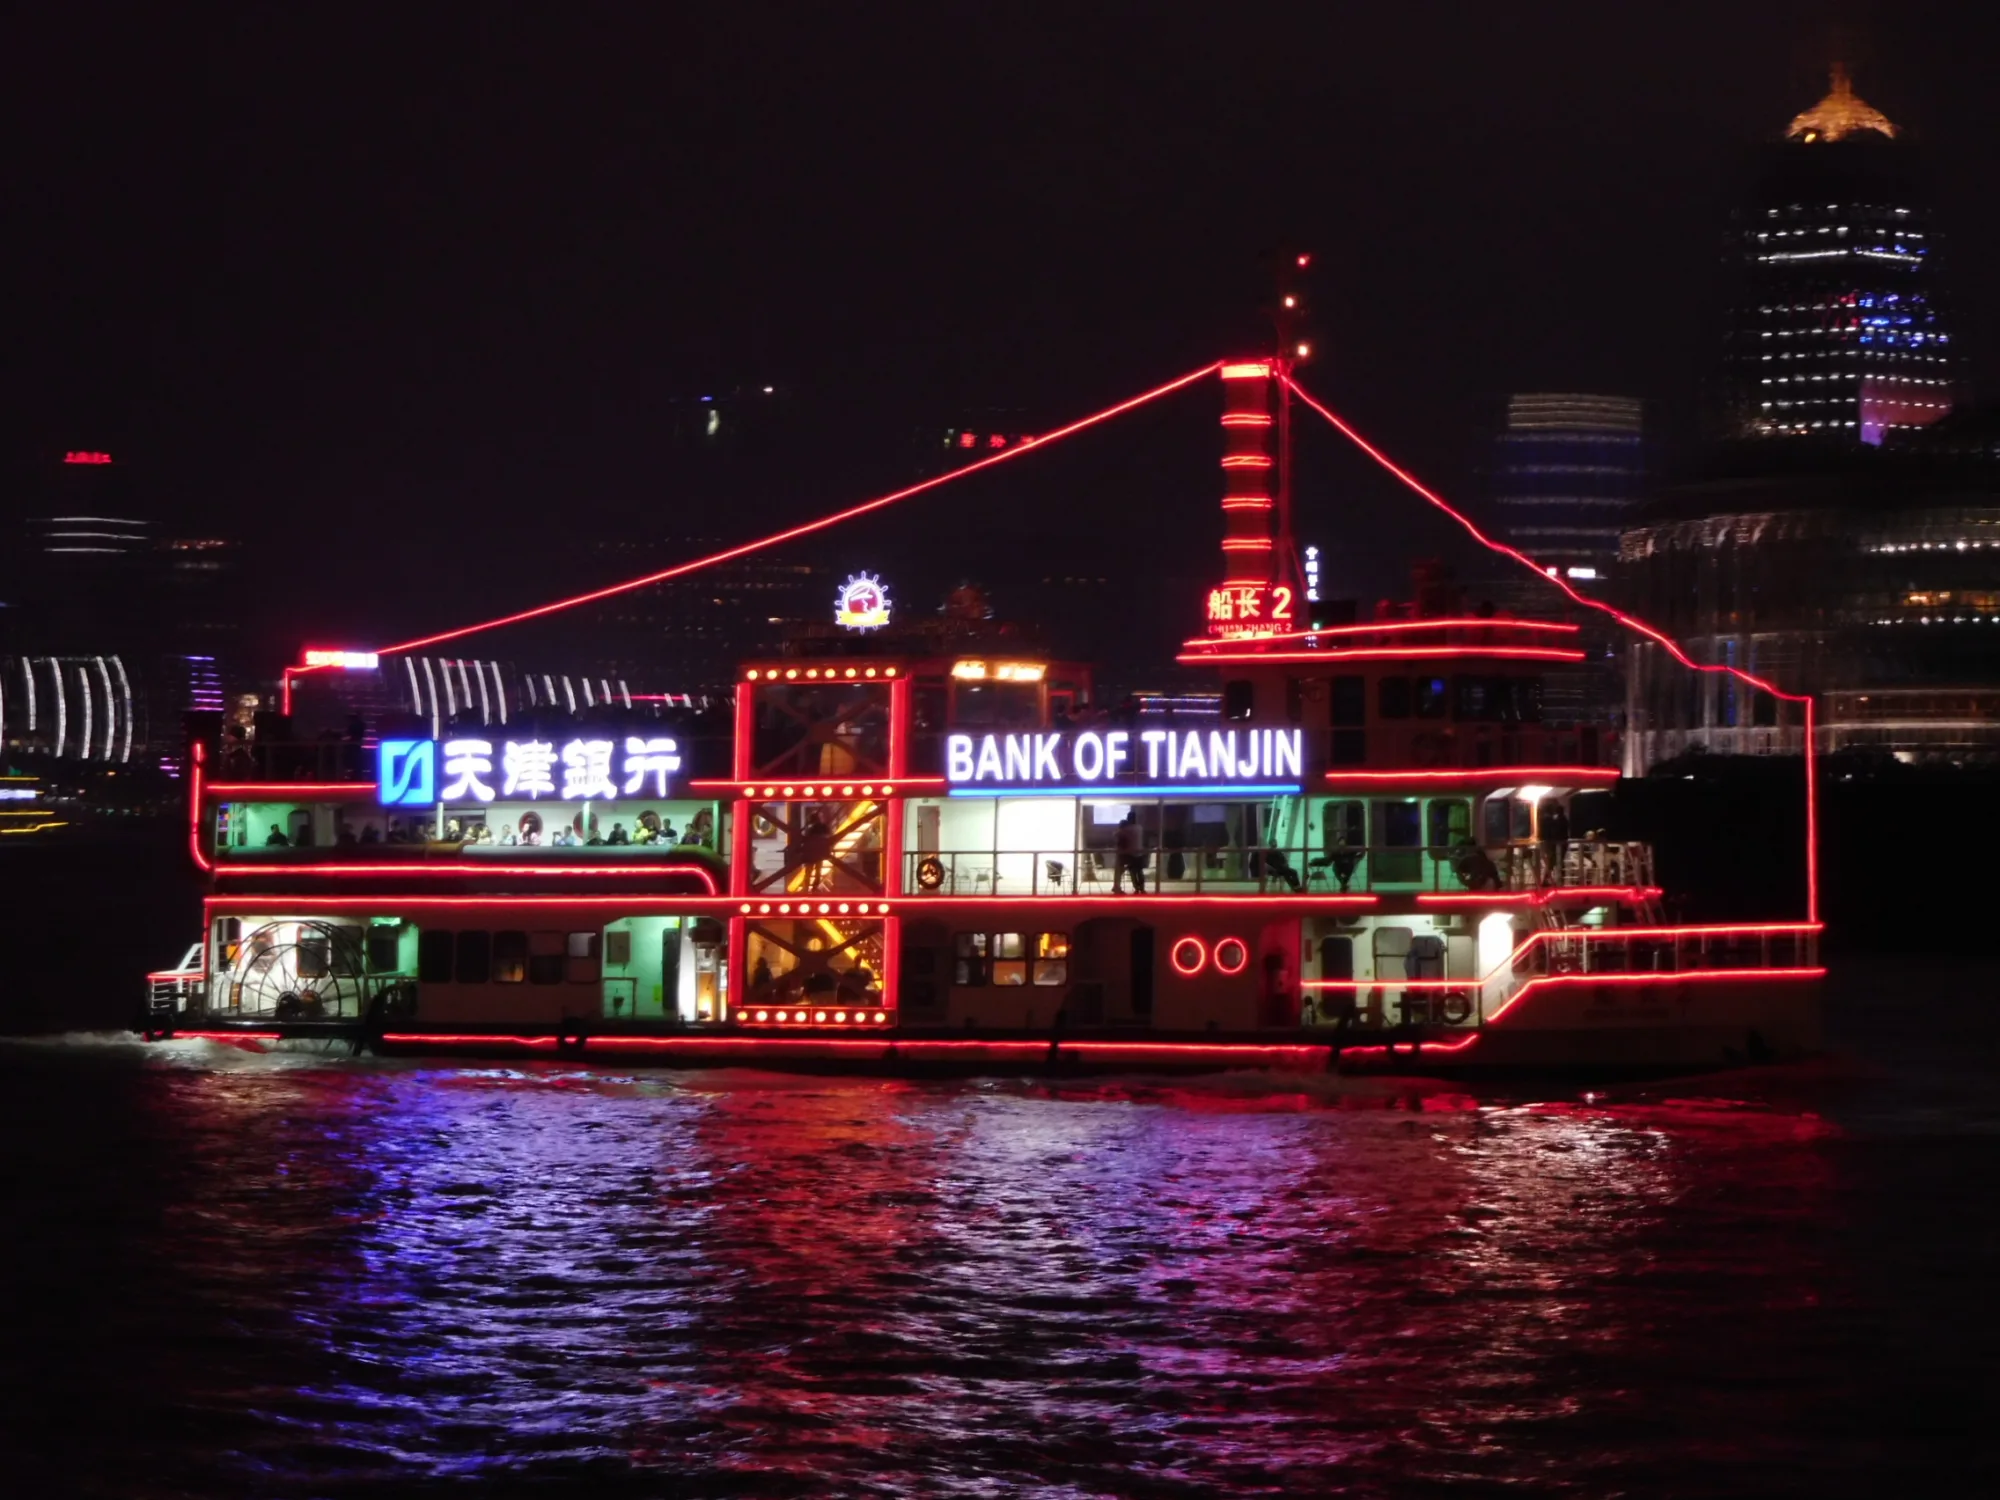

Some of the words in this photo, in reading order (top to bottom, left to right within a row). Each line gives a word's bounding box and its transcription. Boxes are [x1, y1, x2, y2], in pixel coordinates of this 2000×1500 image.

[1208, 588, 1260, 619] 船长
[1272, 586, 1291, 618] 2
[1285, 623, 1292, 632] 2
[949, 733, 1061, 781] BANK
[1074, 731, 1129, 780] OF
[1141, 729, 1302, 778] TIANJIN
